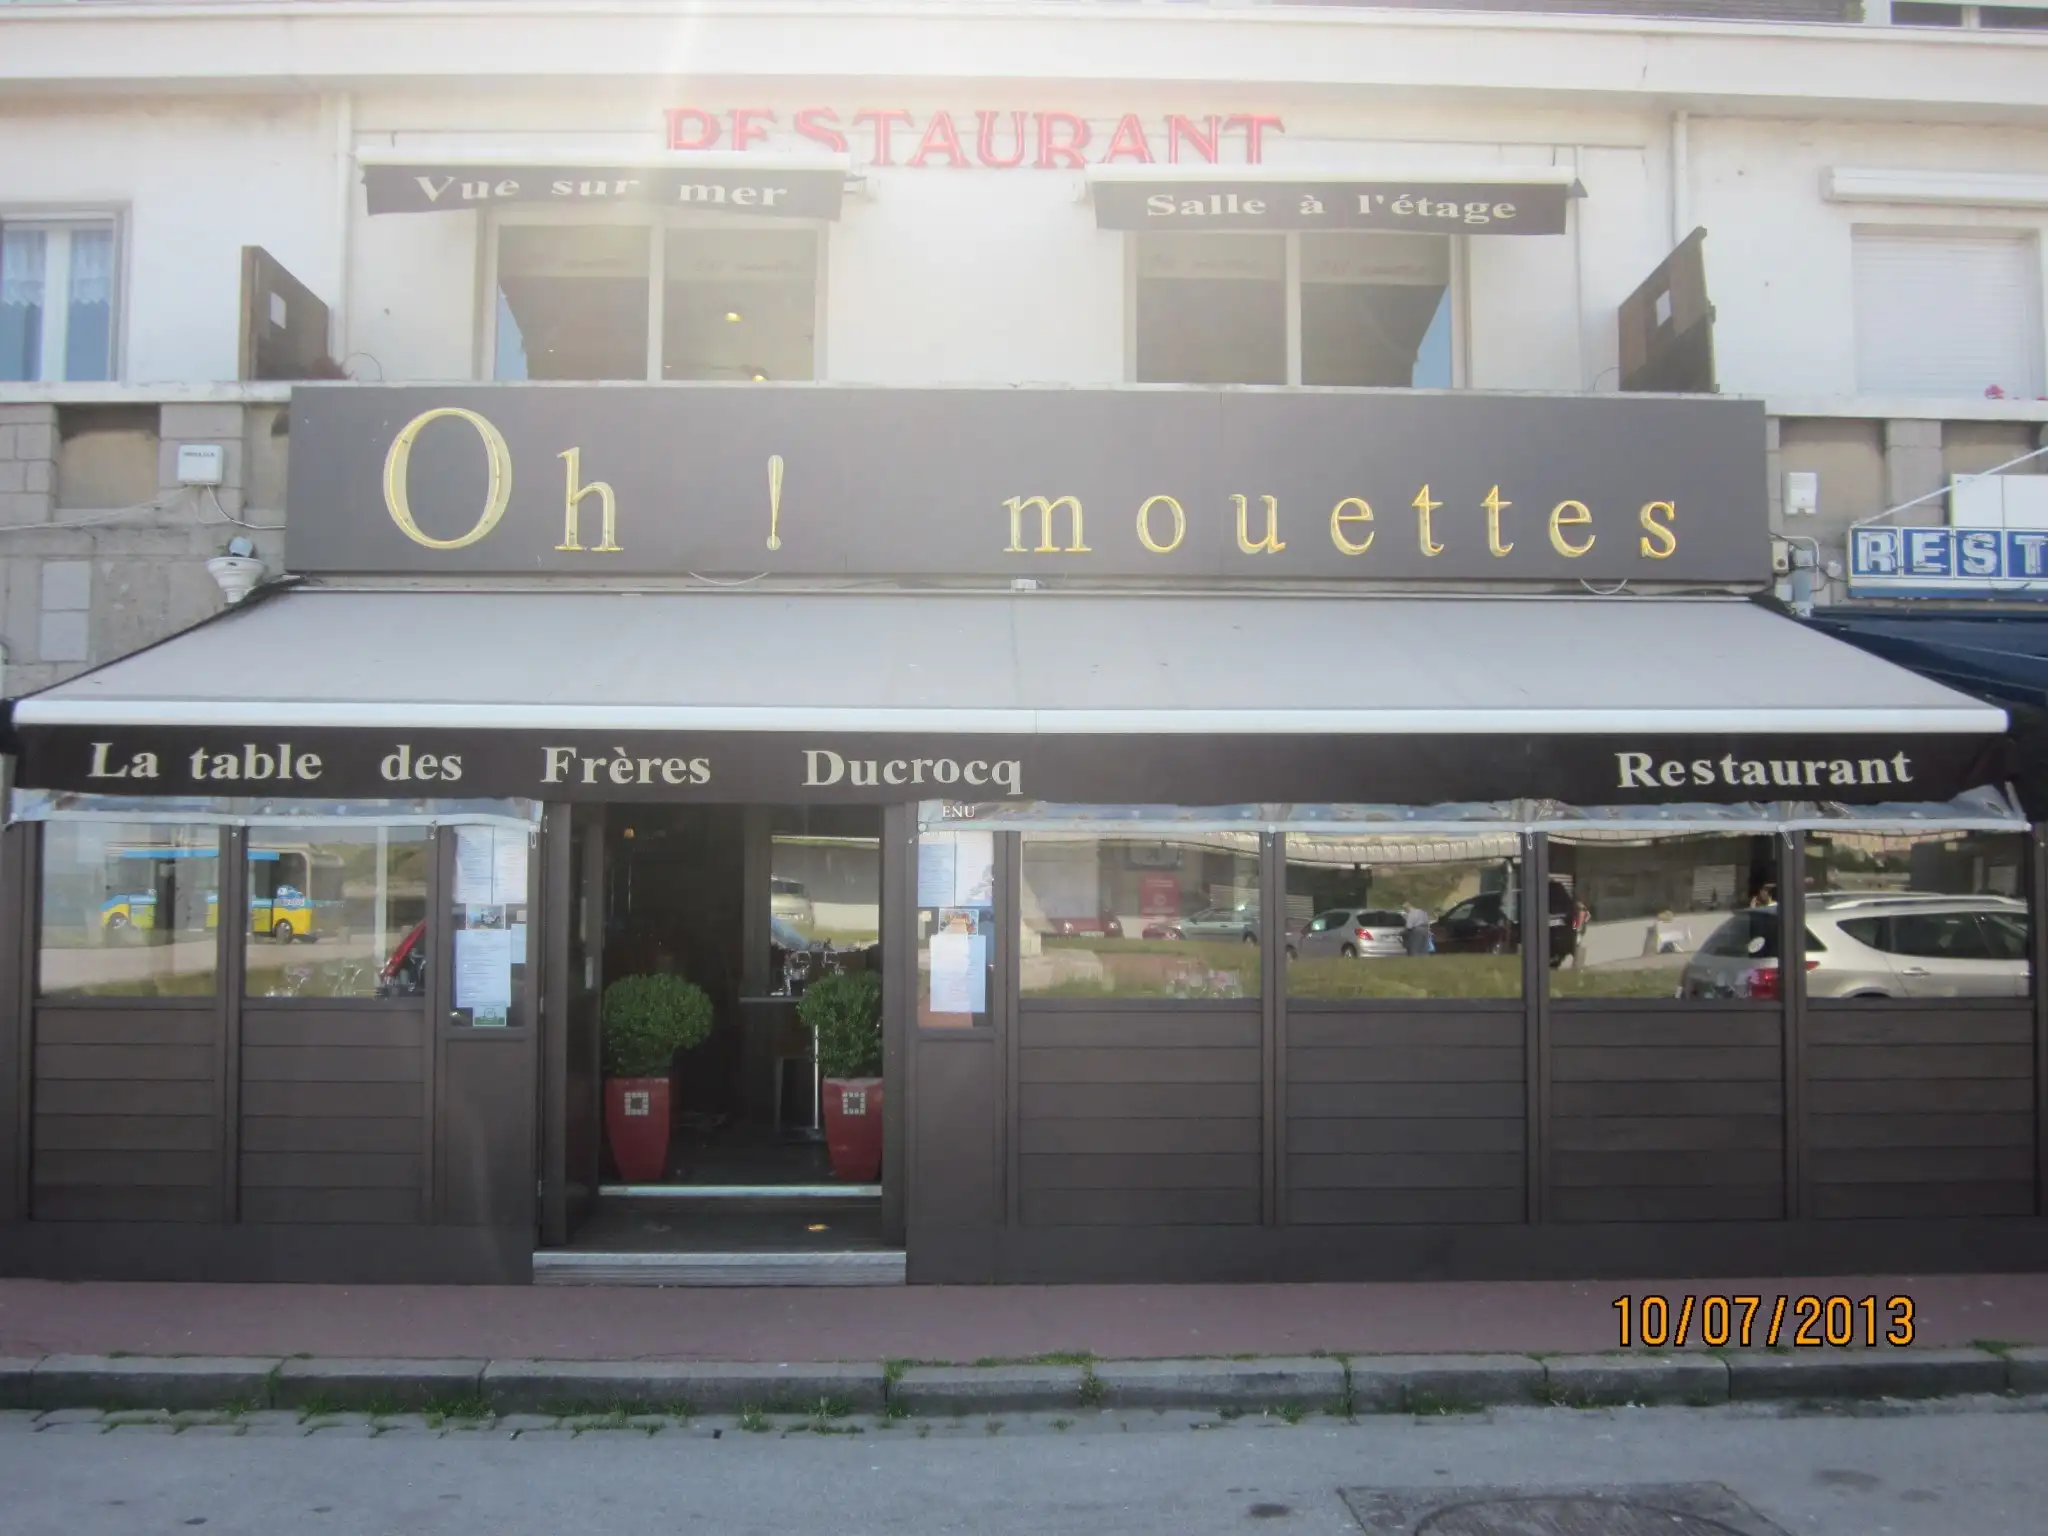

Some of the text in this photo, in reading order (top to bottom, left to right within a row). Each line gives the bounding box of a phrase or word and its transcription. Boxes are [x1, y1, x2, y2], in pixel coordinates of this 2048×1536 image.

[666, 108, 1285, 169] RESTAURANT
[414, 176, 788, 207] Vue sur mer
[1147, 194, 1518, 225] Salle à l'étage
[383, 407, 1677, 557] Oh ! mouettes
[1857, 530, 2048, 575] REST
[86, 742, 1023, 795] La table des Frères Ducrocq
[1615, 750, 1914, 788] Restaurant
[942, 805, 975, 818] ENU
